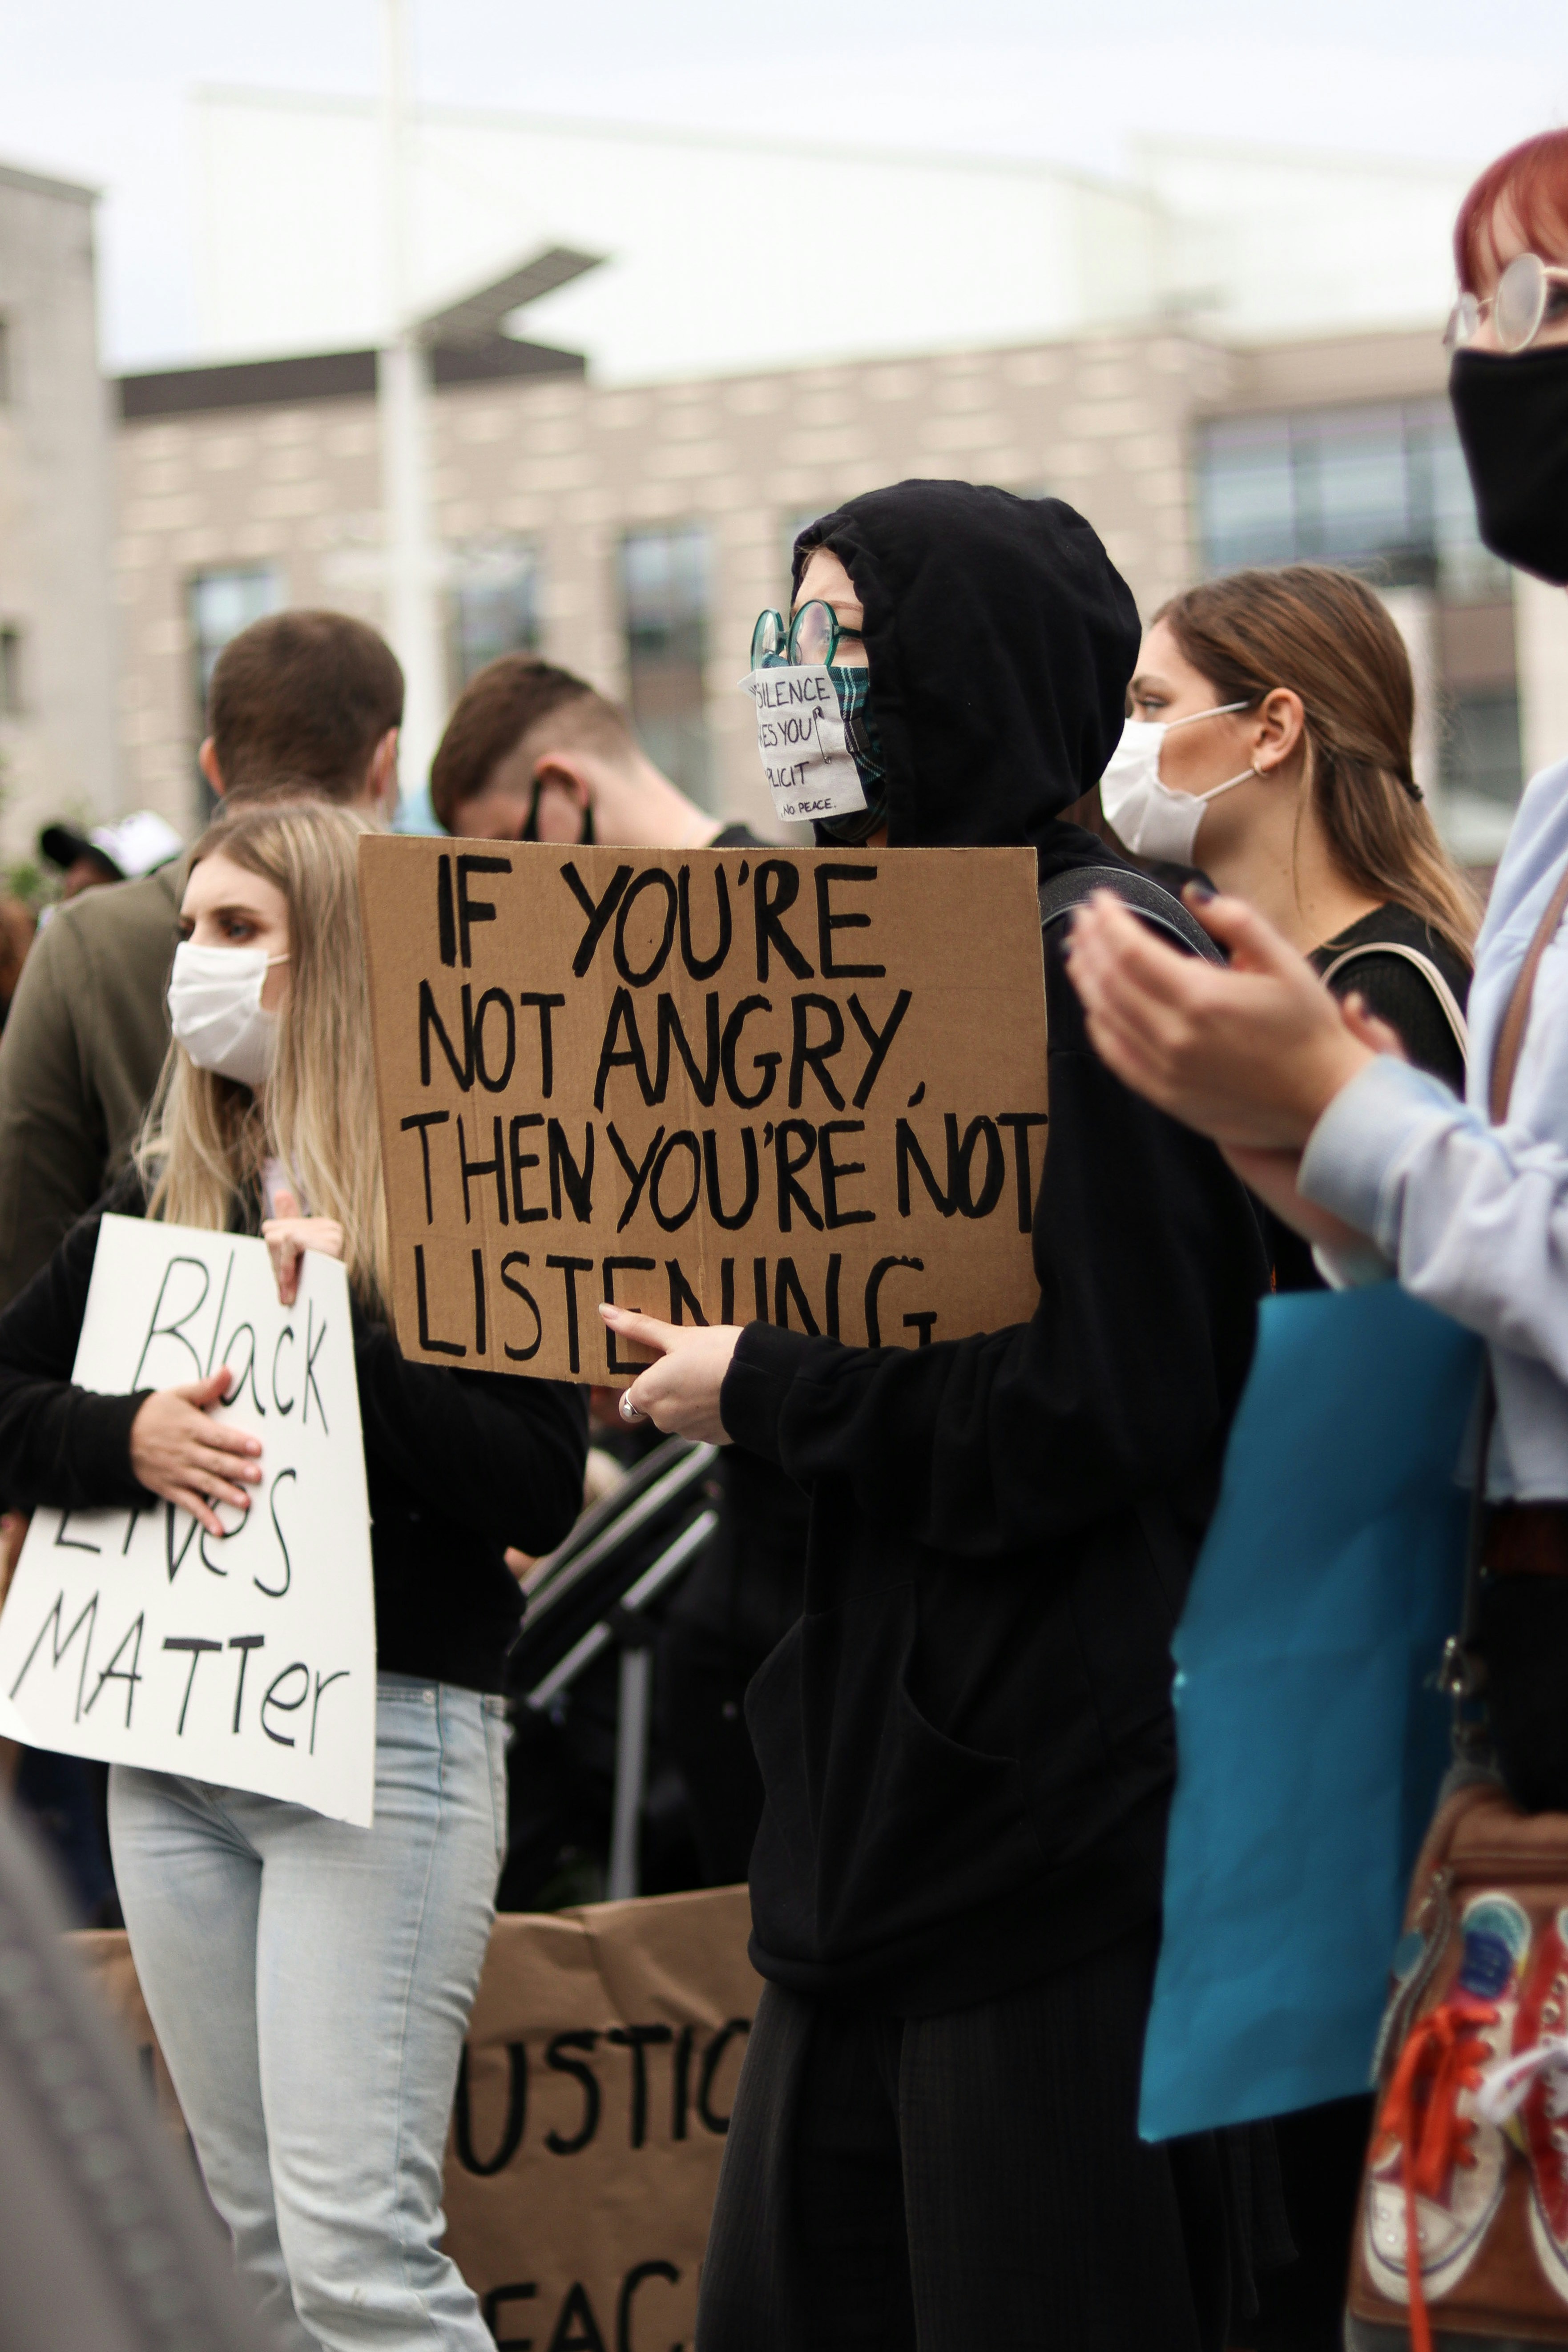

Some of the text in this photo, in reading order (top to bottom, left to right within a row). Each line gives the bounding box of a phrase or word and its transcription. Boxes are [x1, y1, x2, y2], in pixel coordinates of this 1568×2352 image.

[756, 677, 831, 709] SILENCE
[777, 718, 812, 746] YOU
[766, 761, 810, 788] PLICIT
[783, 798, 837, 816] NO PEACE.
[438, 854, 887, 988] IF YOU'RE
[419, 978, 926, 1112] NOT ANGRY,
[400, 1111, 1048, 1234] THEN YOU'RE NOT
[131, 1249, 329, 1437] Black
[414, 1244, 937, 1375] LISTENING
[455, 2018, 753, 2177] USTIC
[485, 2259, 685, 2352] EAC
